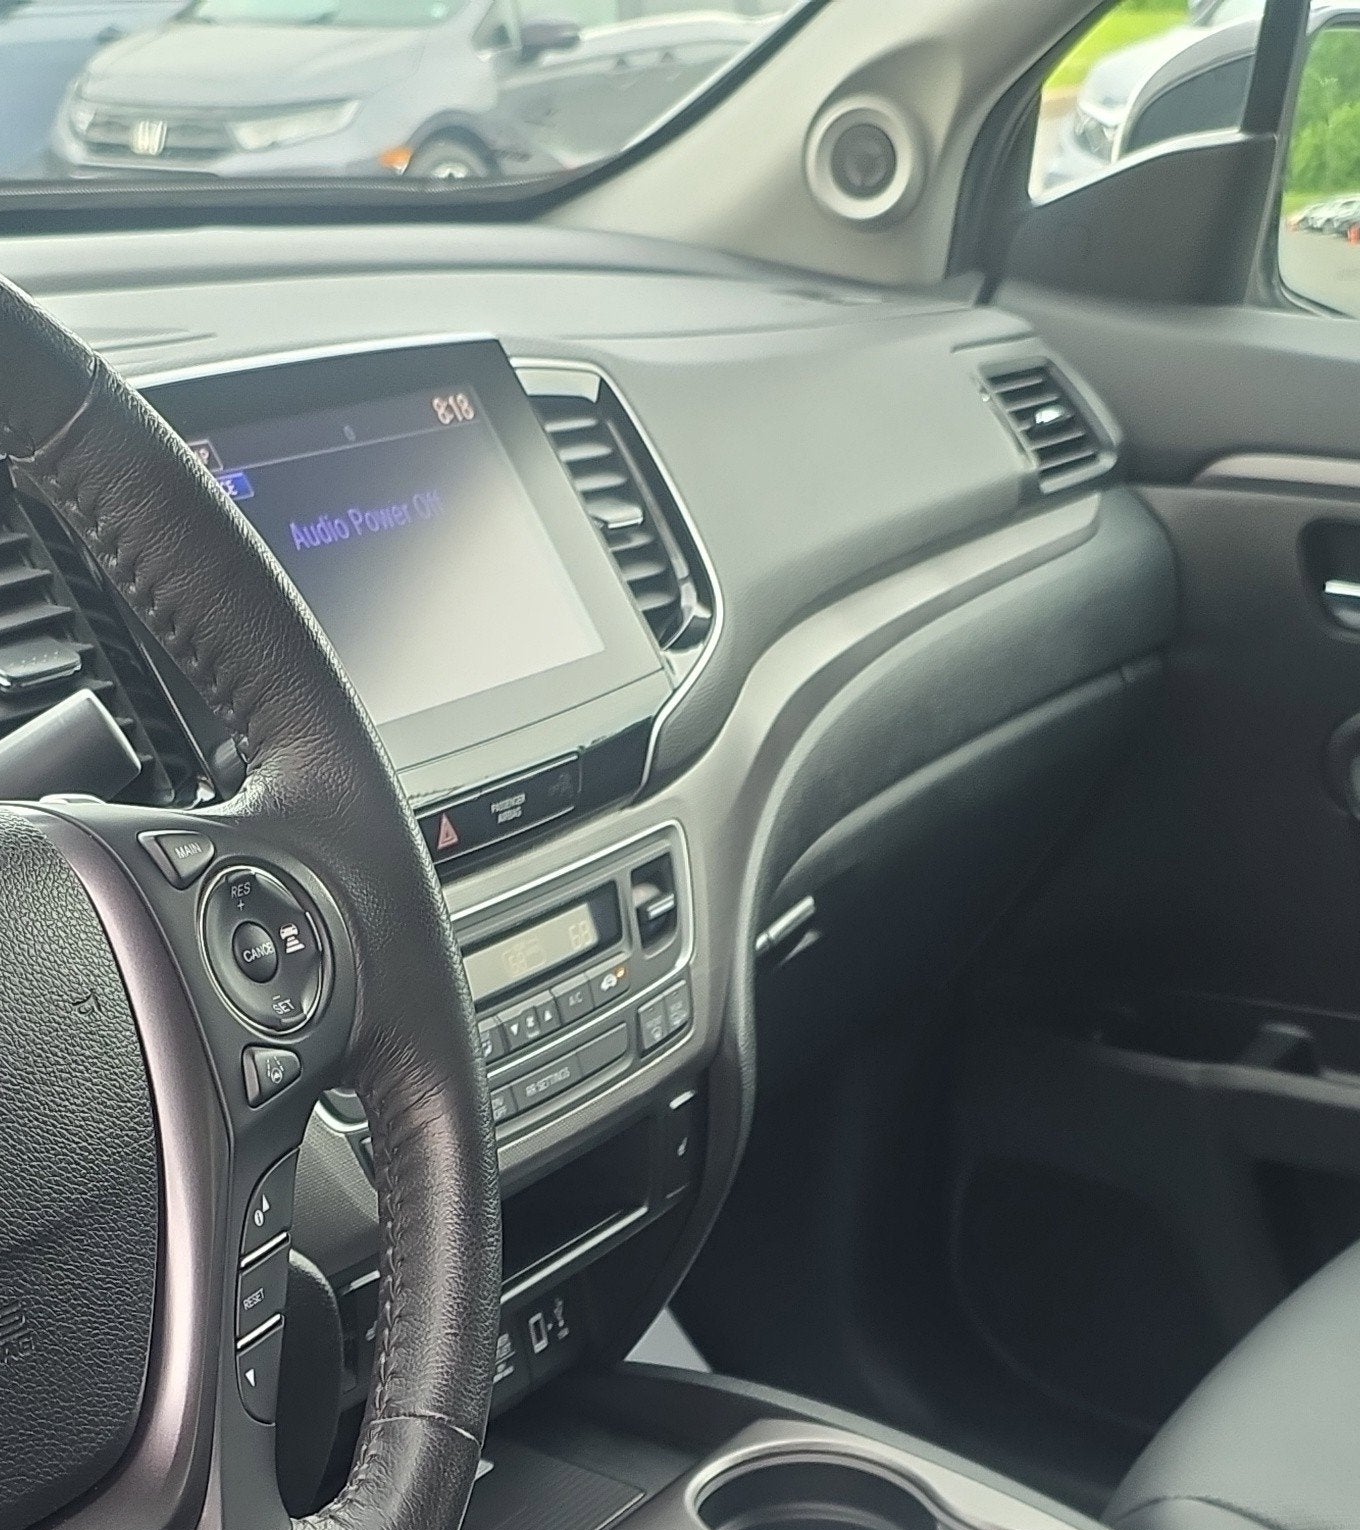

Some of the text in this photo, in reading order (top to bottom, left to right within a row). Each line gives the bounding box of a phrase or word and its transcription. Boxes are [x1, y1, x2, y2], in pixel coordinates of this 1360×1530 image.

[290, 514, 350, 551] Audio
[347, 505, 410, 536] Power
[175, 842, 202, 859] MAIN
[231, 881, 251, 899] RES
[272, 998, 295, 1014] SET
[243, 1287, 265, 1311] RESET
